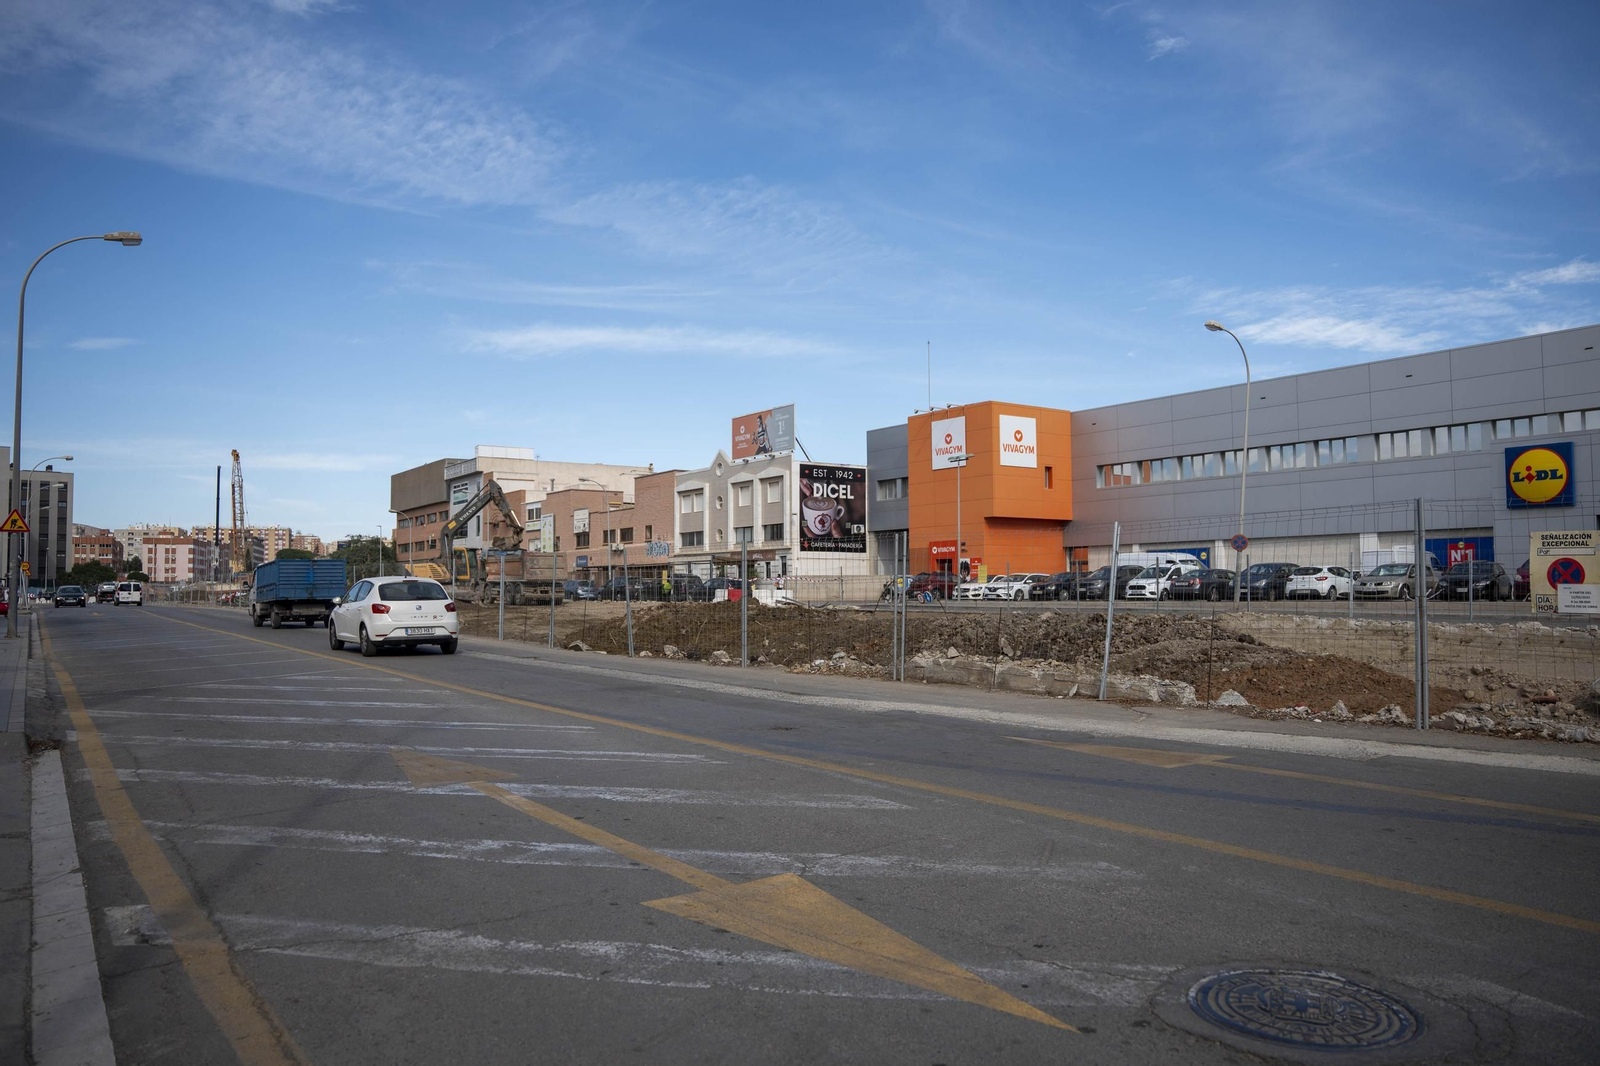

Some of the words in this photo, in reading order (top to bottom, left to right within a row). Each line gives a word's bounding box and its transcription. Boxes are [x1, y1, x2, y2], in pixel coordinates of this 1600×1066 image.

[935, 445, 963, 456] VIVAGYM
[1002, 443, 1035, 454] VIVAGYM
[813, 468, 828, 477] EST
[835, 470, 854, 480] 1942
[813, 482, 855, 499] DICEL
[459, 506, 477, 521] VOLVO
